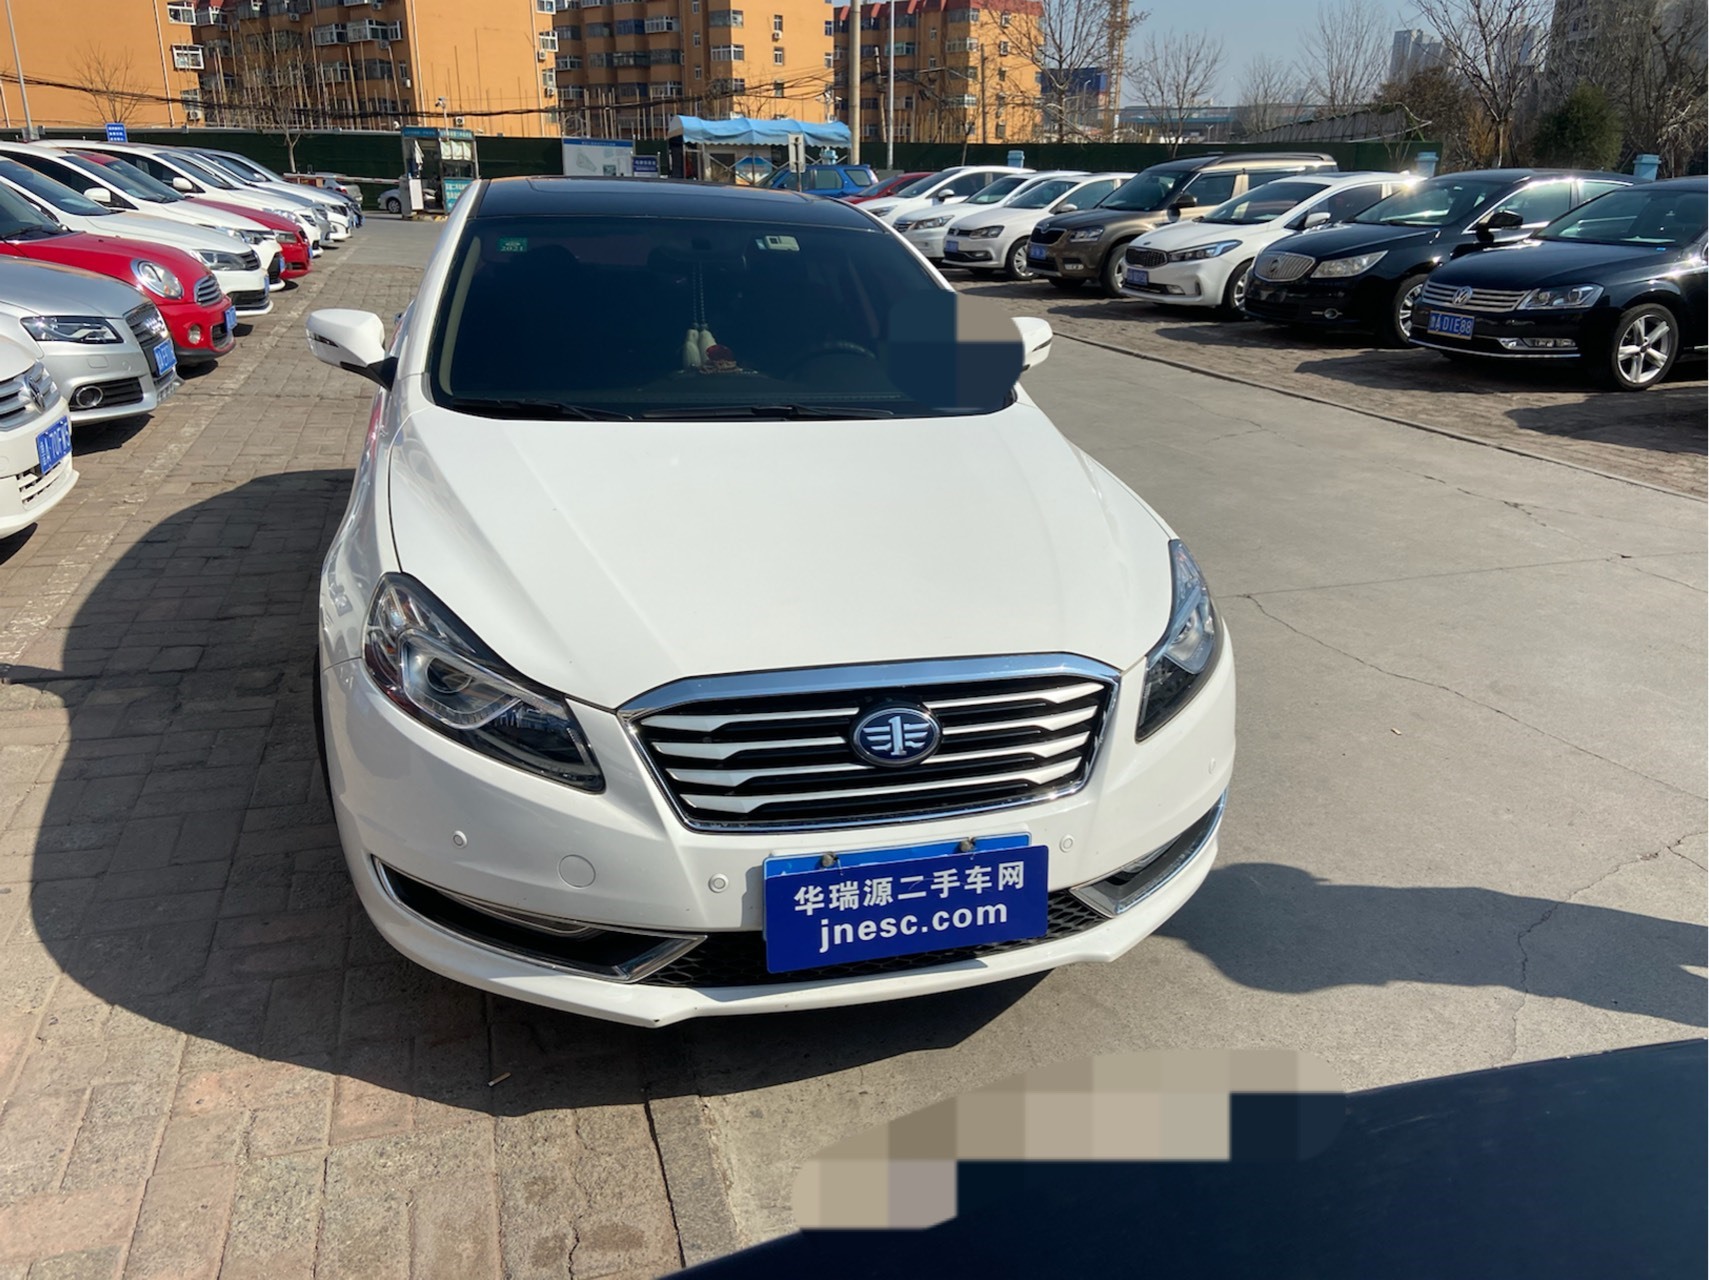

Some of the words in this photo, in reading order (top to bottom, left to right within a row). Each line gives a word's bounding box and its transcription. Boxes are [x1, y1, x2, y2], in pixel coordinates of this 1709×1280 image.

[795, 861, 1024, 916] 华瑞源二手车网
[820, 904, 1007, 953] jnesc.com
